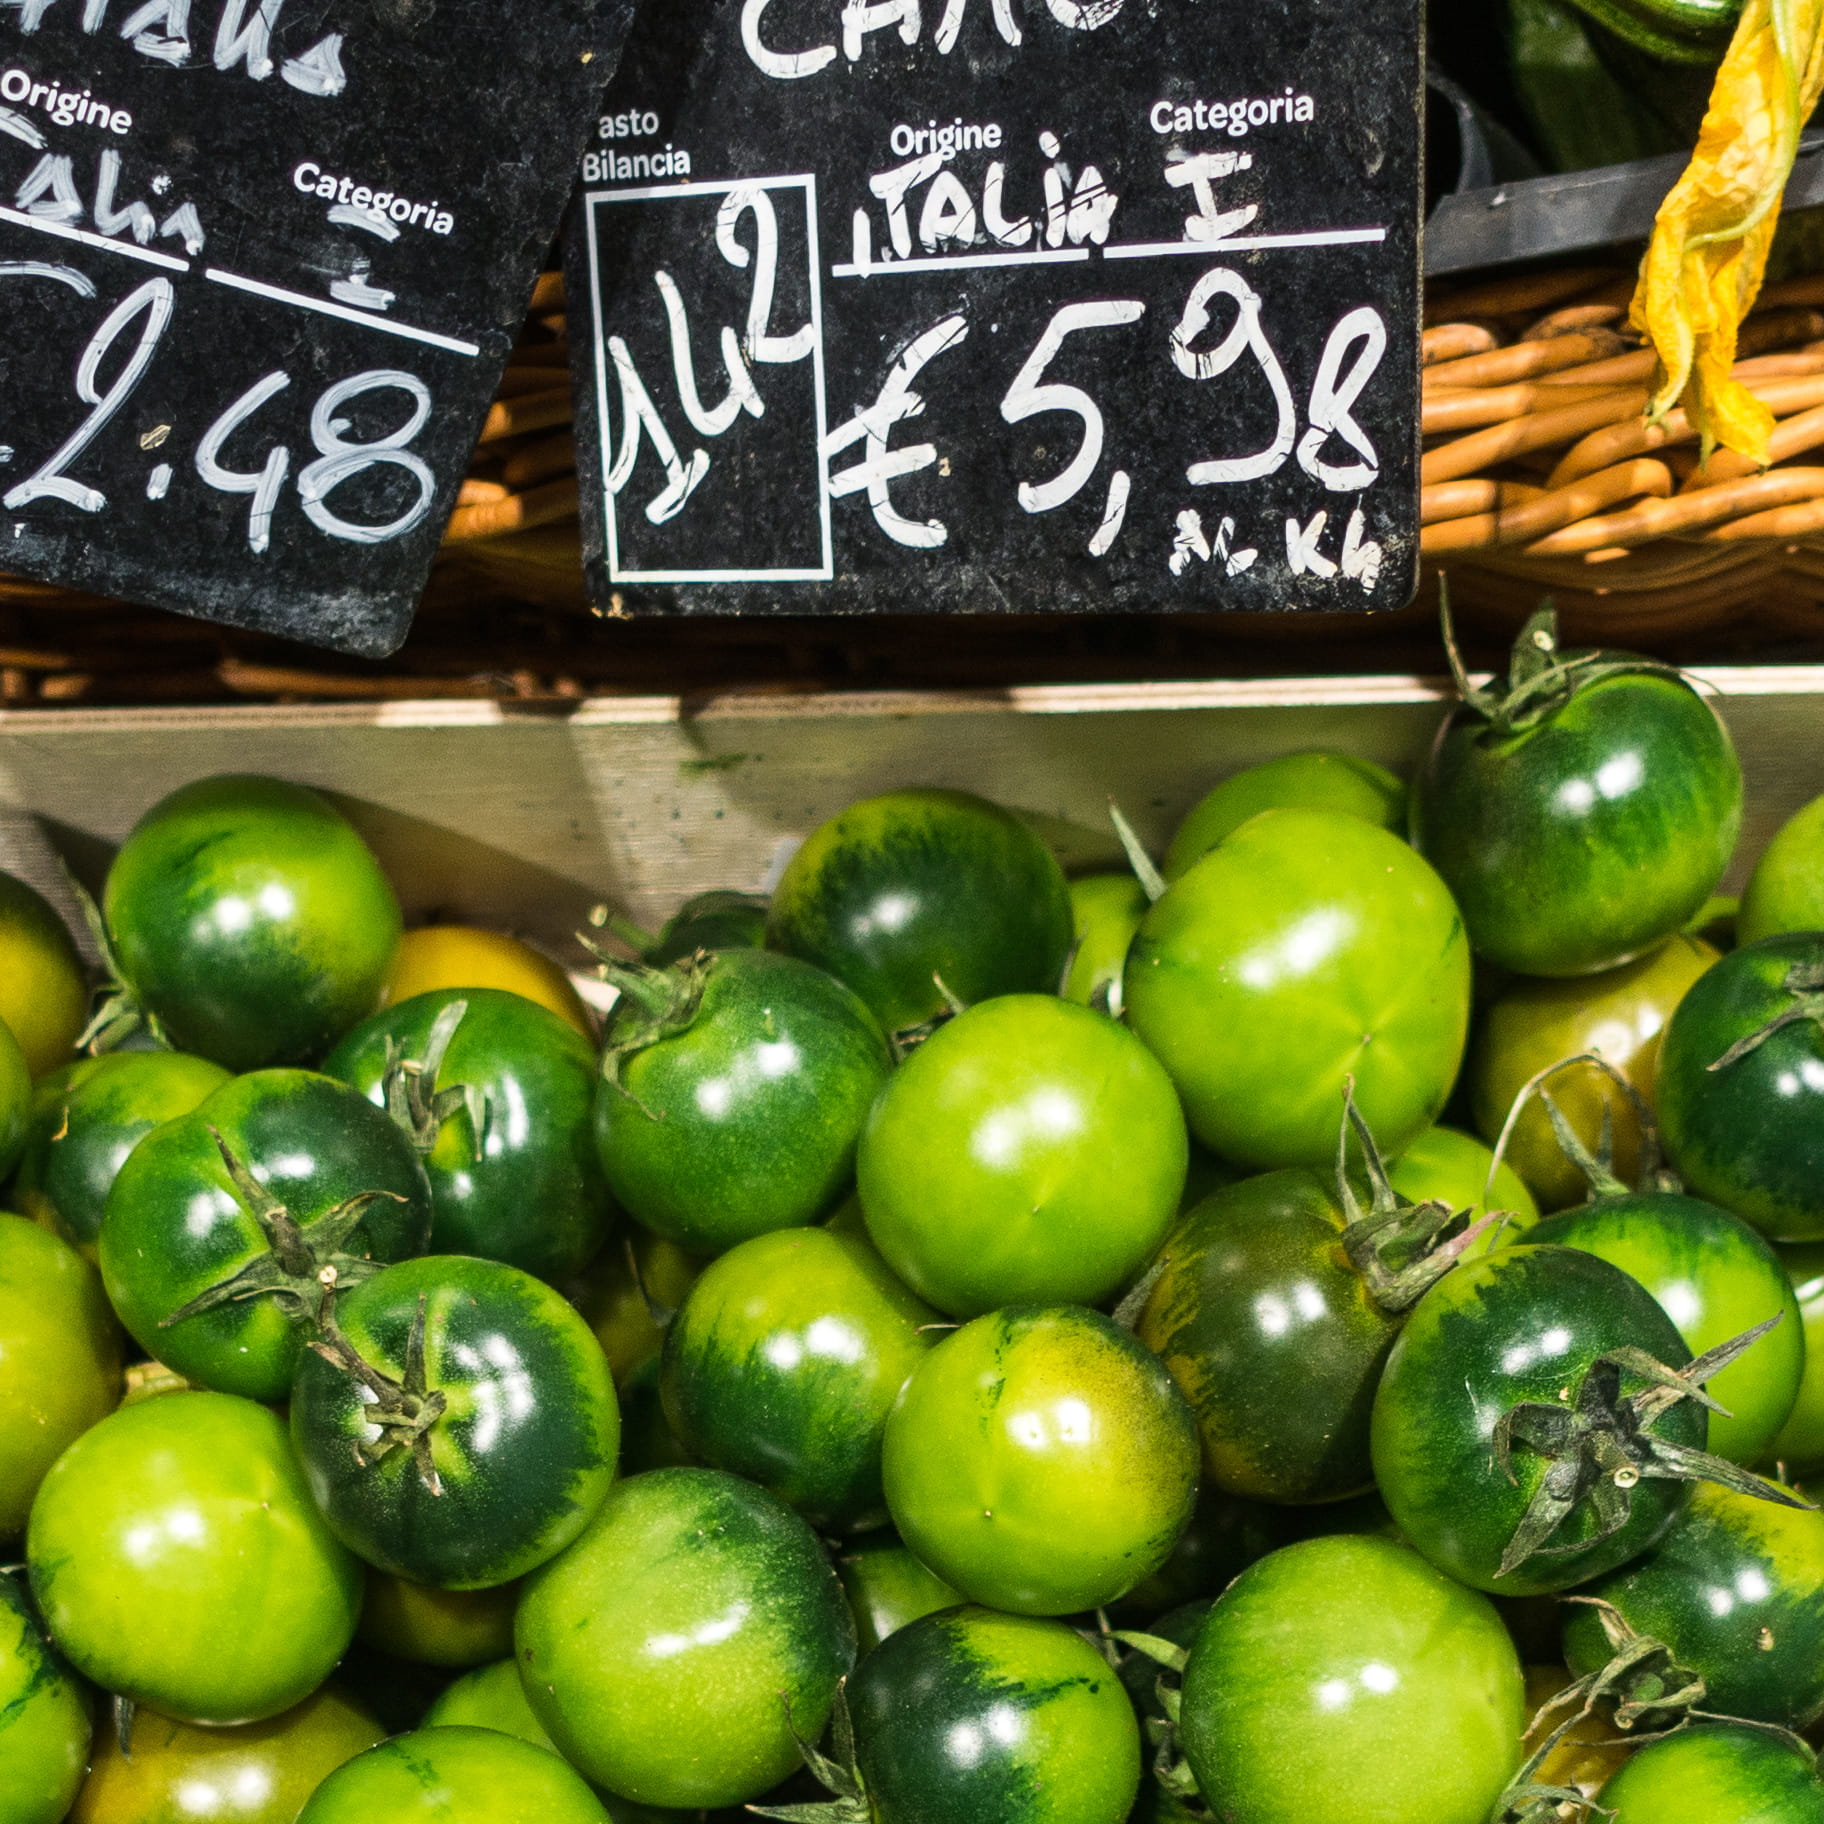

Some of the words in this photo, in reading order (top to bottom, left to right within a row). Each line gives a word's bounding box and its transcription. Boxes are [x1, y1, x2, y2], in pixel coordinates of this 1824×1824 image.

[0, 68, 133, 136] Origine
[598, 108, 660, 139] asto
[1149, 87, 1315, 136] Categoria
[890, 118, 1002, 159] Origine
[582, 143, 691, 182] Bilancia
[291, 161, 456, 236] Categoria
